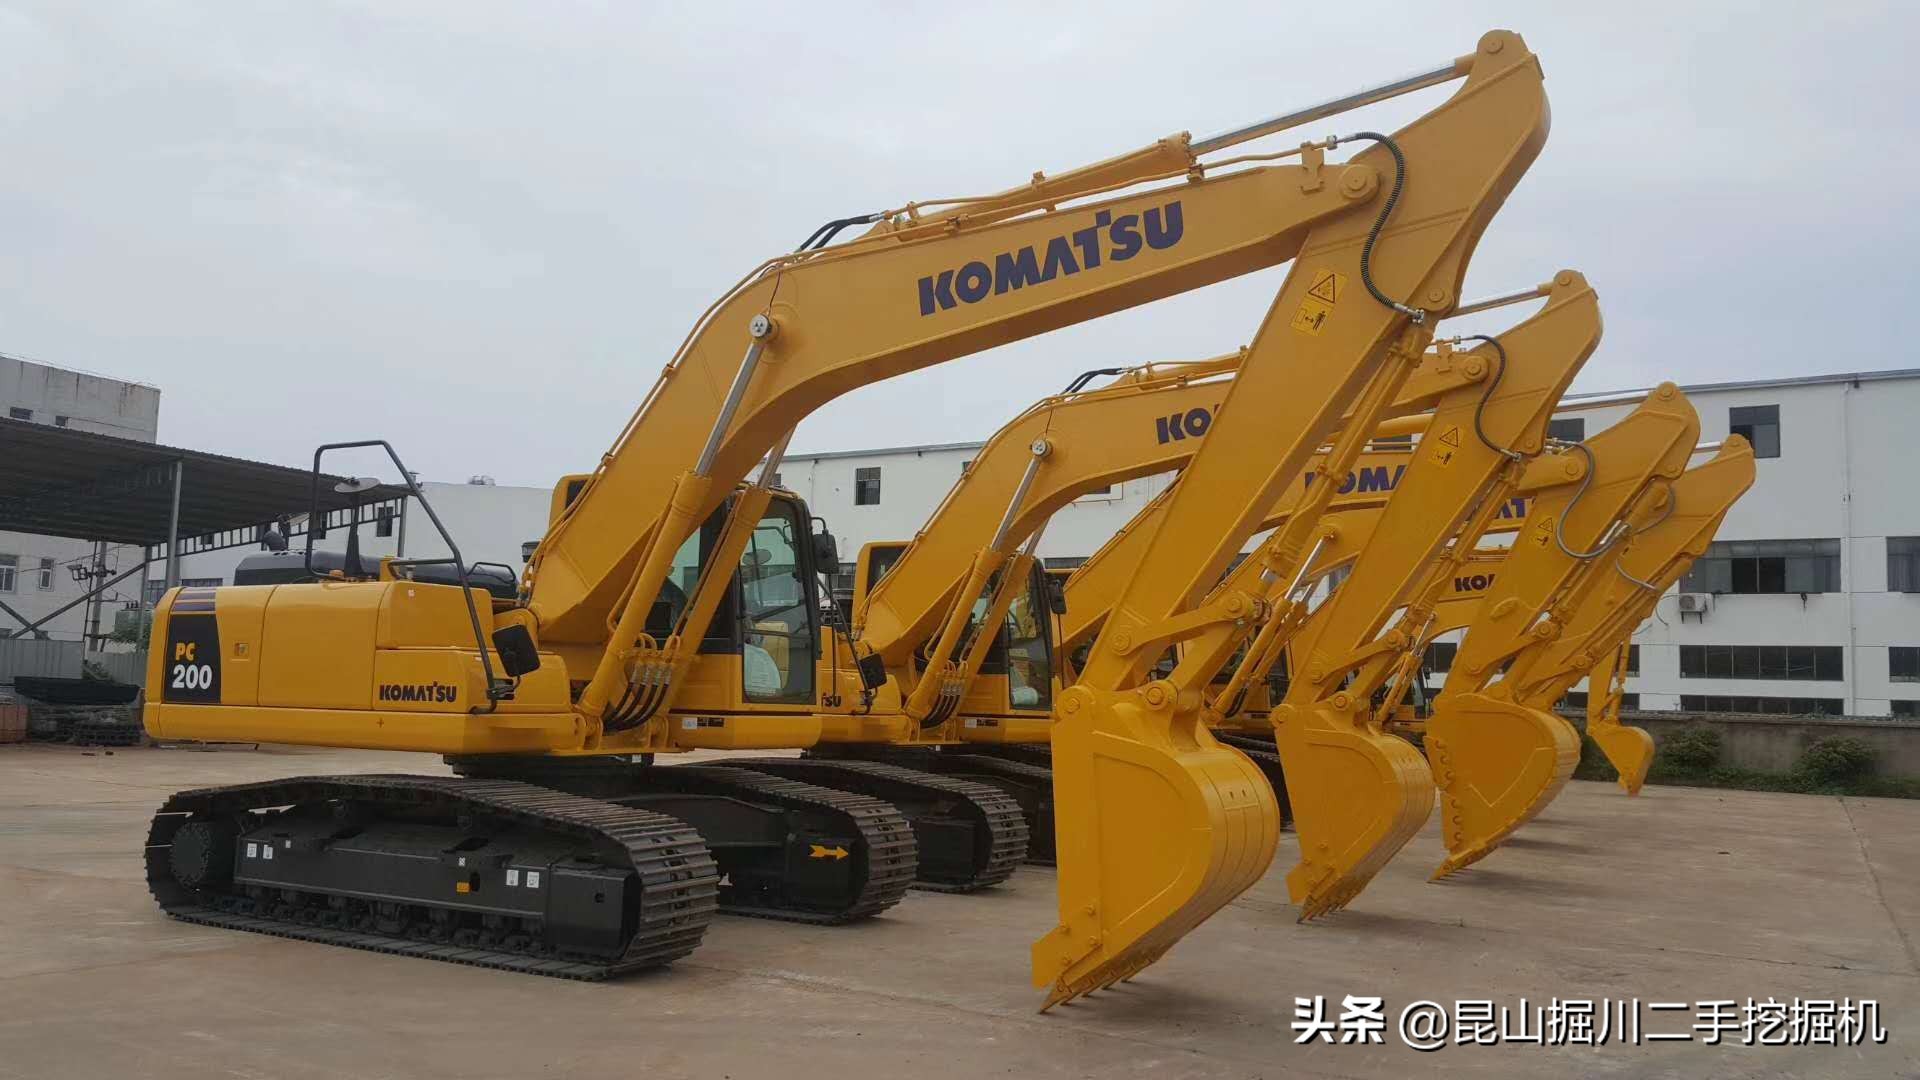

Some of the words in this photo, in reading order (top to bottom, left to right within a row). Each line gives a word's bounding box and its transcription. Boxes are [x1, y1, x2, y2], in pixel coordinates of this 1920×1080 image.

[918, 200, 1184, 316] KOMATSU
[1156, 403, 1220, 445] KO
[175, 642, 195, 661] PC
[172, 664, 213, 690] 200
[379, 681, 457, 702] KOMATSU
